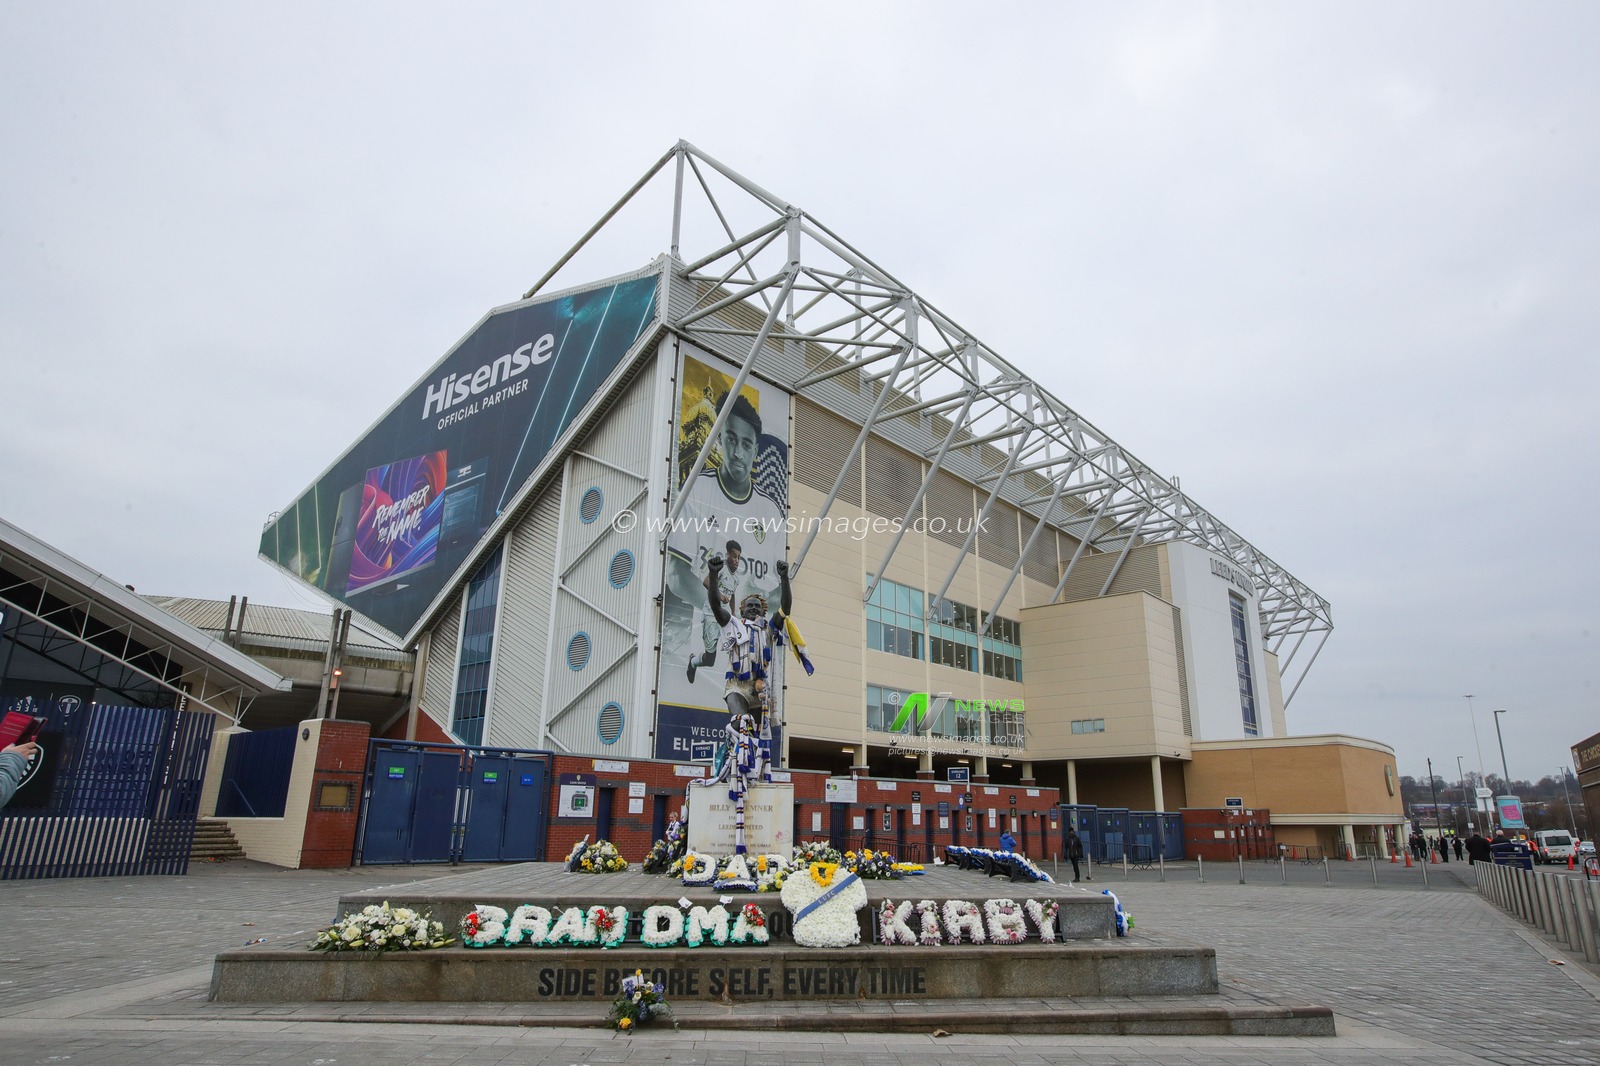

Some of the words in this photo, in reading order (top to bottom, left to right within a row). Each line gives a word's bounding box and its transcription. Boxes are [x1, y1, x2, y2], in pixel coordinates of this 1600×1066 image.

[421, 333, 555, 420] Hisense
[437, 402, 479, 430] OFFICIAL
[482, 378, 529, 410] PARTNER
[372, 485, 430, 529] REMEMBER
[691, 726, 727, 739] WELCO
[700, 750, 706, 758] 13
[709, 804, 730, 812] BILLY
[879, 898, 1060, 945] KIRBY
[538, 967, 597, 996] SIDE
[708, 967, 774, 998] SELF,
[783, 967, 860, 996] EVERY
[867, 967, 927, 994] TIME
